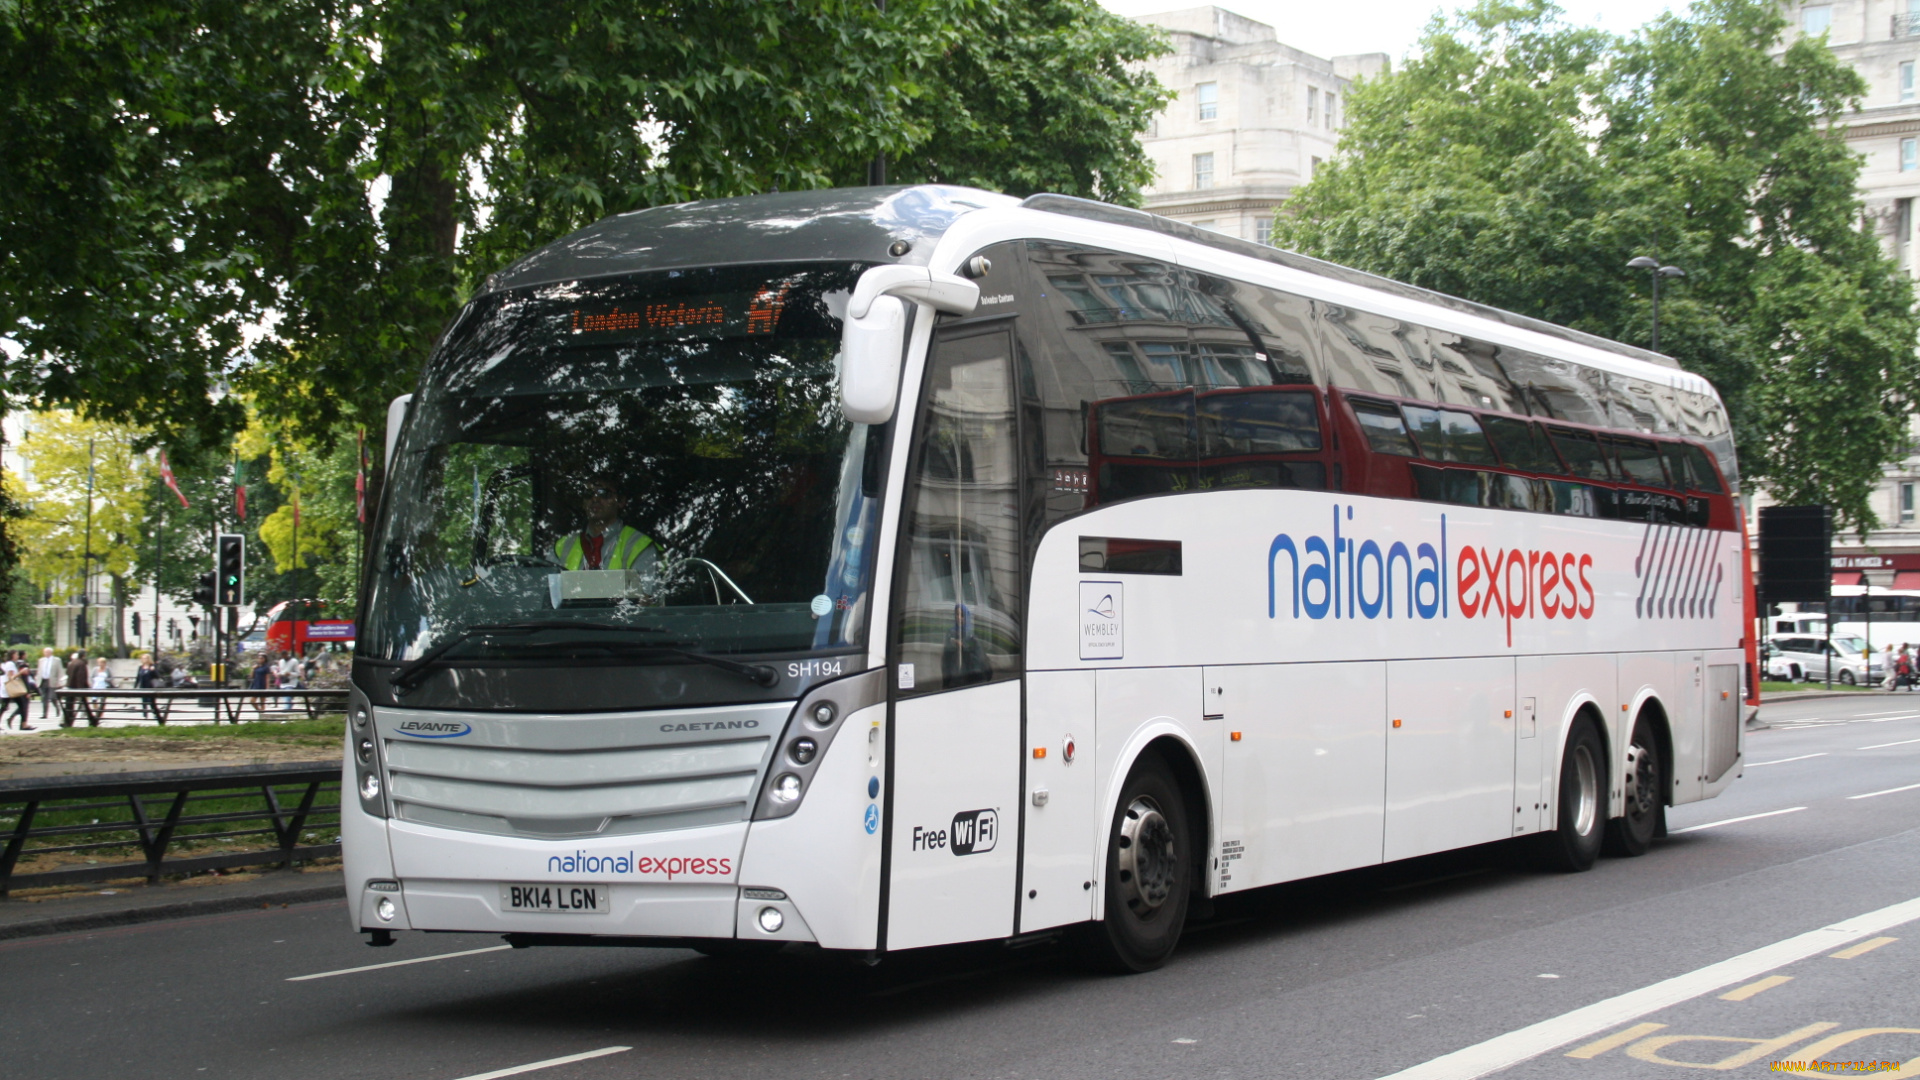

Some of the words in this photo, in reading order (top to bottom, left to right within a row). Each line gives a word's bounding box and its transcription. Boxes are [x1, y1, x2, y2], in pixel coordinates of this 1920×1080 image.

[572, 308, 639, 333] London
[646, 301, 723, 327] Victoria
[1268, 504, 1447, 619] national
[1457, 545, 1594, 648] express
[1084, 623, 1118, 636] WEMBLEY
[787, 661, 842, 678] SH194
[400, 721, 461, 733] LEVANTE
[659, 720, 759, 733] CAETANO
[912, 826, 946, 852] Free
[548, 850, 633, 873] national
[638, 857, 731, 881] express
[511, 886, 552, 908] BK14
[557, 888, 596, 909] LGN
